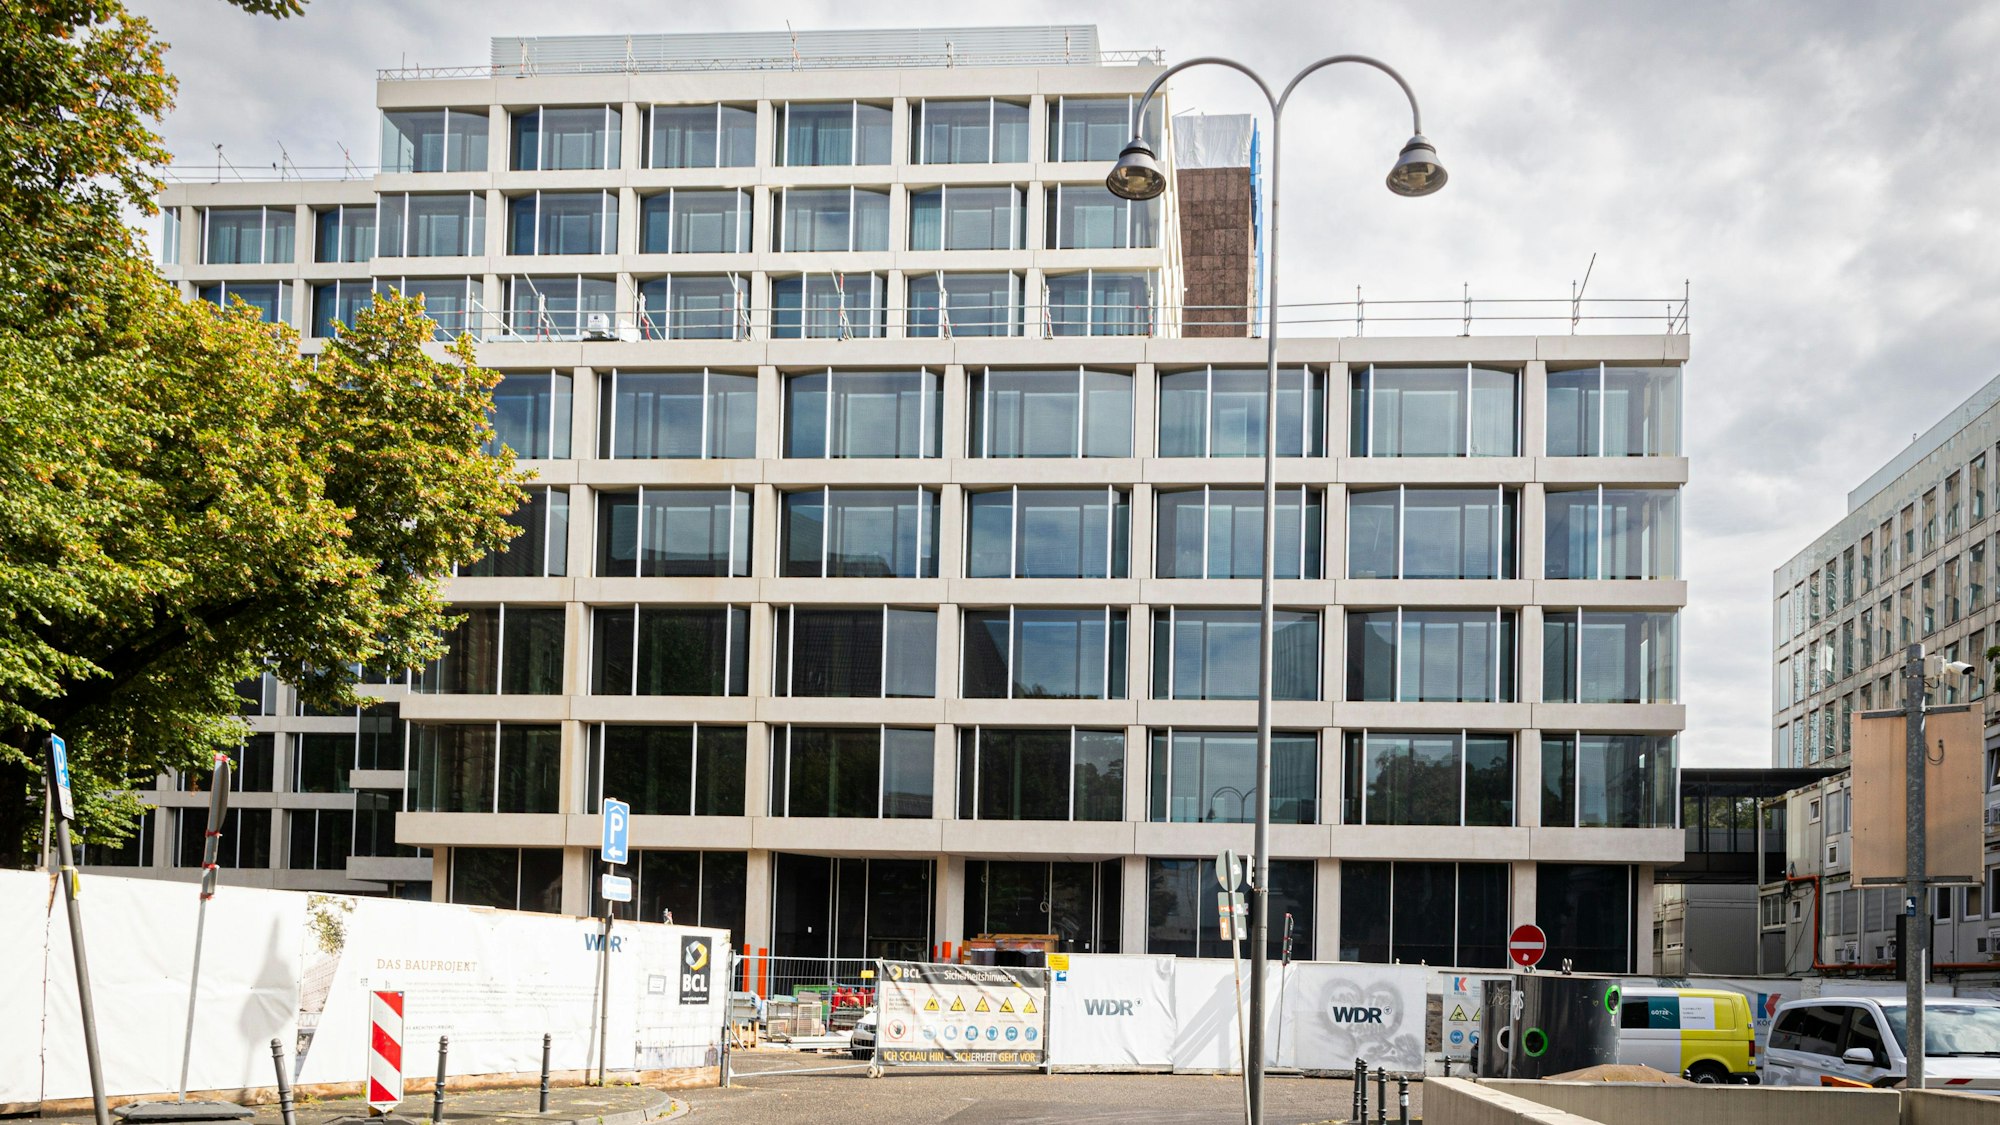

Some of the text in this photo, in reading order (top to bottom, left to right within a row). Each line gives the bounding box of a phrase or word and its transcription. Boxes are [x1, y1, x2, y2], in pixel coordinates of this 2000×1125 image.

[609, 812, 624, 844] P
[377, 959, 477, 973] DAS BAUPROJEKT
[903, 968, 921, 979] BCL
[682, 973, 708, 992] BCL
[1083, 999, 1134, 1016] WDR
[1332, 1006, 1382, 1024] WDR
[883, 1051, 898, 1061] ICH
[900, 1051, 927, 1062] SCHAU
[929, 1051, 944, 1062] HIN
[954, 1052, 996, 1062] SICHERHEIT
[998, 1053, 1018, 1062] GEHT
[1020, 1053, 1036, 1062] VOR
